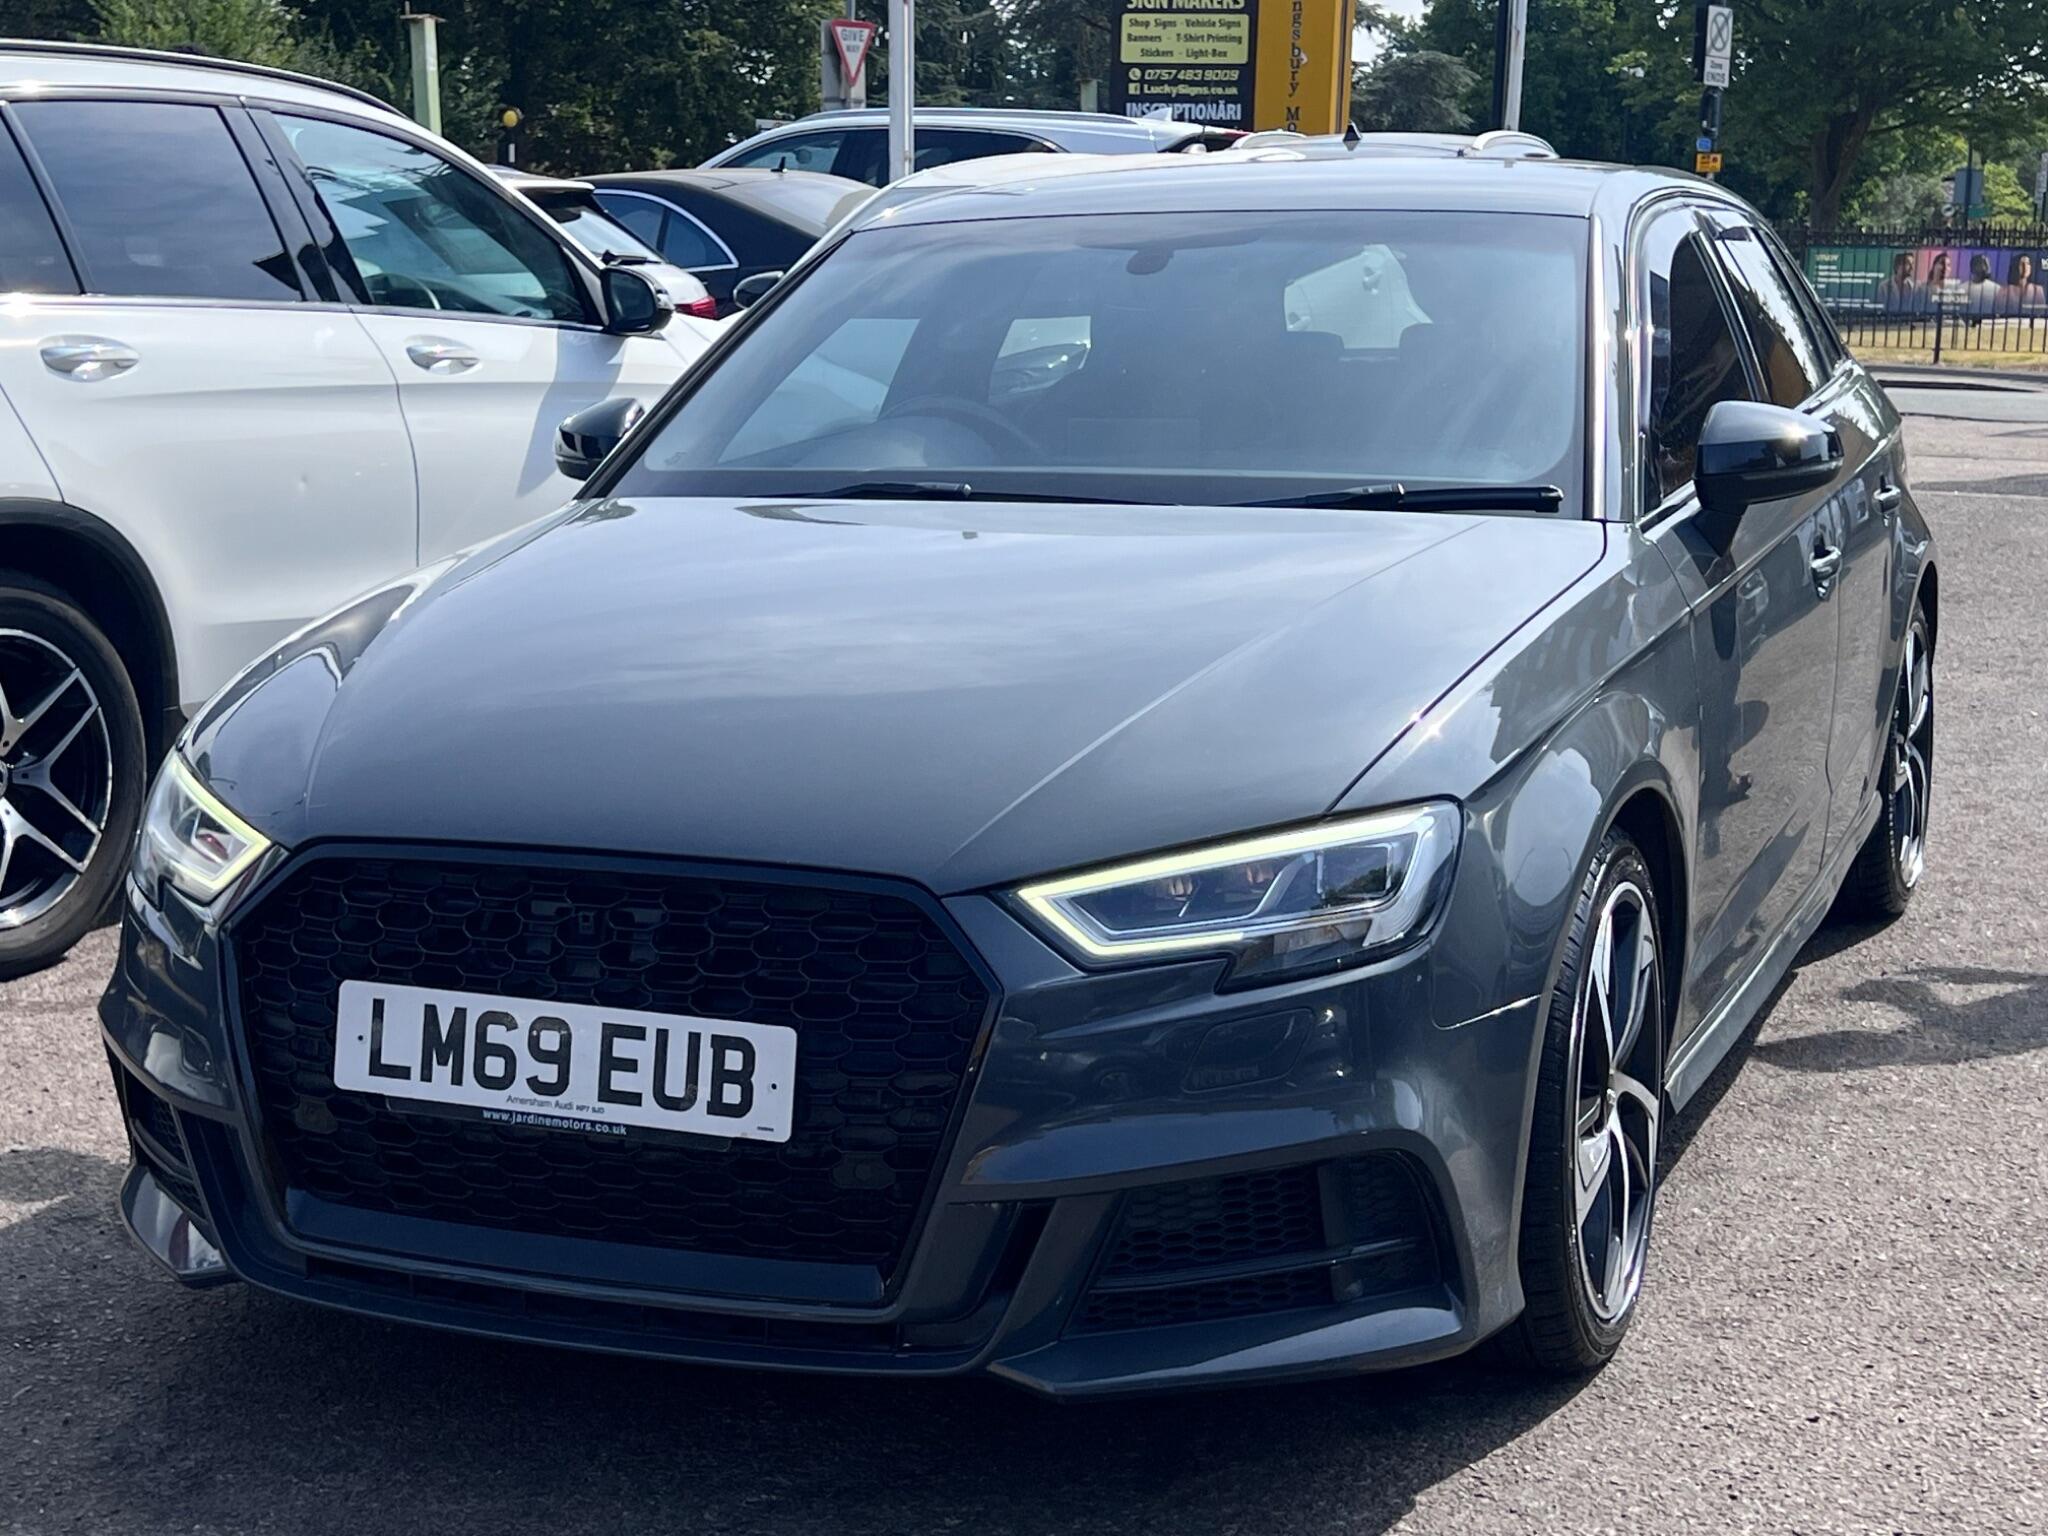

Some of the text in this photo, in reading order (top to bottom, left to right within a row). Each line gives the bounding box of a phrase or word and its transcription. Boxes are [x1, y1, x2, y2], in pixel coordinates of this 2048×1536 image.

[1128, 18, 1241, 30] Shop Signs Vehicle Signs
[840, 28, 865, 42] GIVE
[1127, 33, 1243, 45] Banners T-Shirt Printing
[1140, 48, 1228, 60] Stickers Light-Box
[1144, 69, 1178, 80] 0757
[368, 997, 757, 1119] LM69 EUB
[506, 1094, 553, 1108] Amersham
[554, 1100, 574, 1111] Audi
[482, 1109, 627, 1135] www.jardinemotors.co.uk
